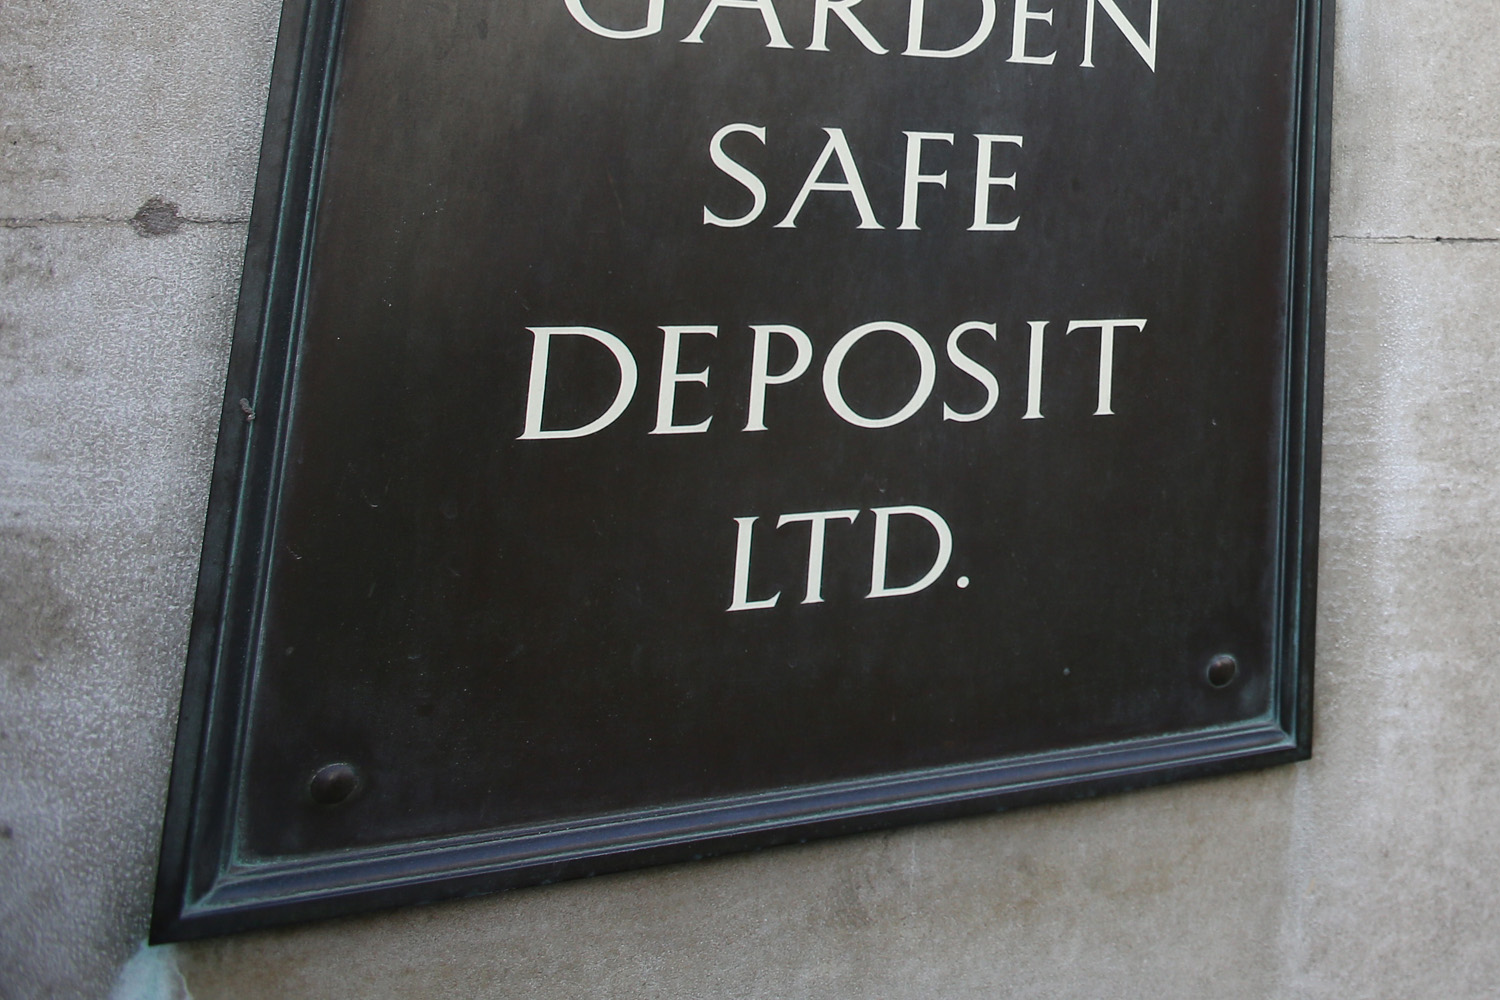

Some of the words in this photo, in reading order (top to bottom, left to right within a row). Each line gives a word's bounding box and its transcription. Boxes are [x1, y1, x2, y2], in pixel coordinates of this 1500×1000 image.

[702, 122, 1024, 231] SAFE
[517, 317, 1148, 441] DEPOSIT
[727, 505, 971, 613] LTD.
